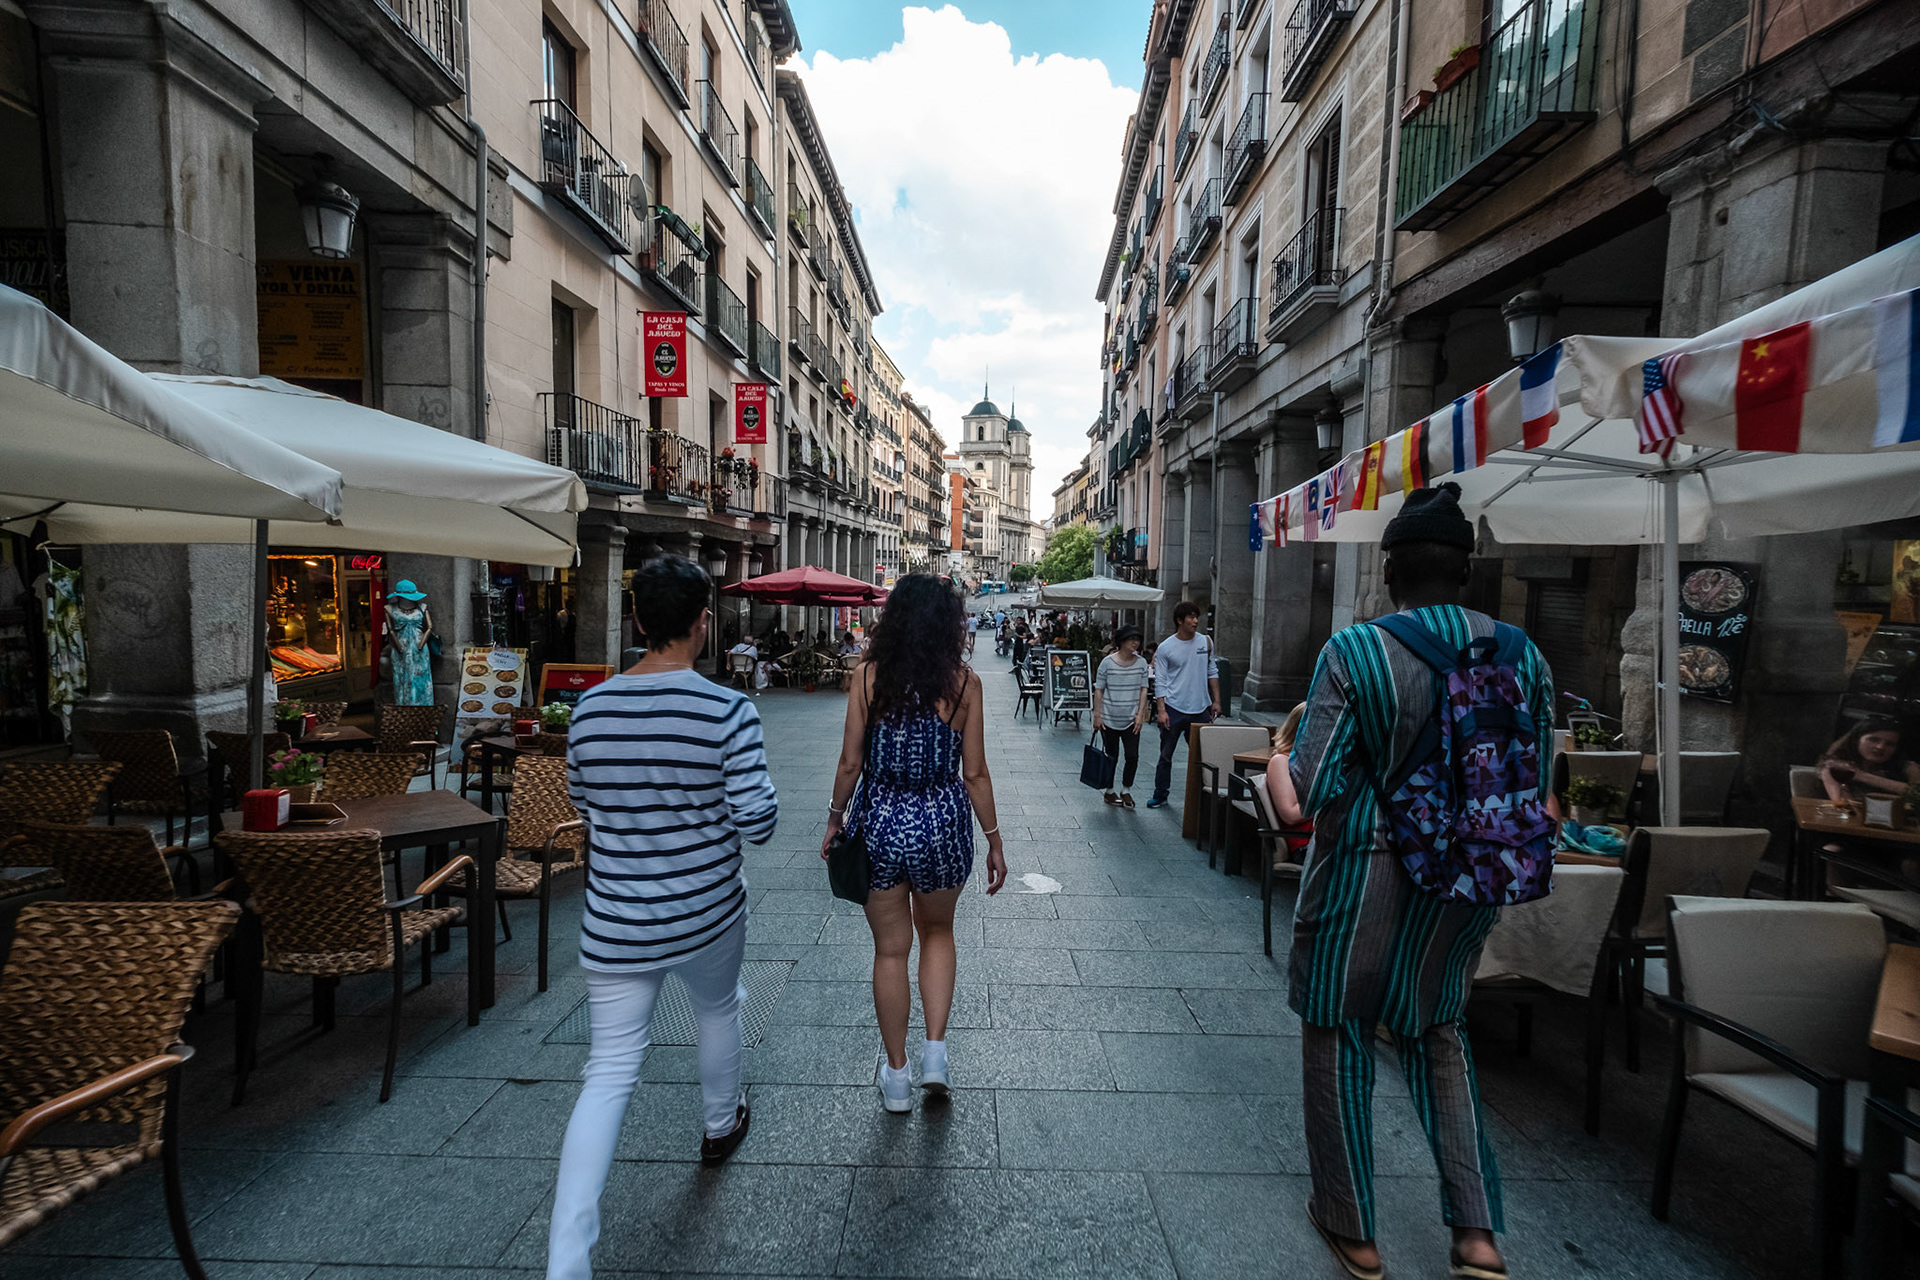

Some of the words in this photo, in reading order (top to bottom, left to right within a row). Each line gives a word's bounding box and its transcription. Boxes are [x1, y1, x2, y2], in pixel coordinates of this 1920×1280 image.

[287, 264, 355, 282] VENTA
[293, 282, 302, 293] Y
[307, 283, 357, 295] DETALL
[660, 316, 683, 324] CASA
